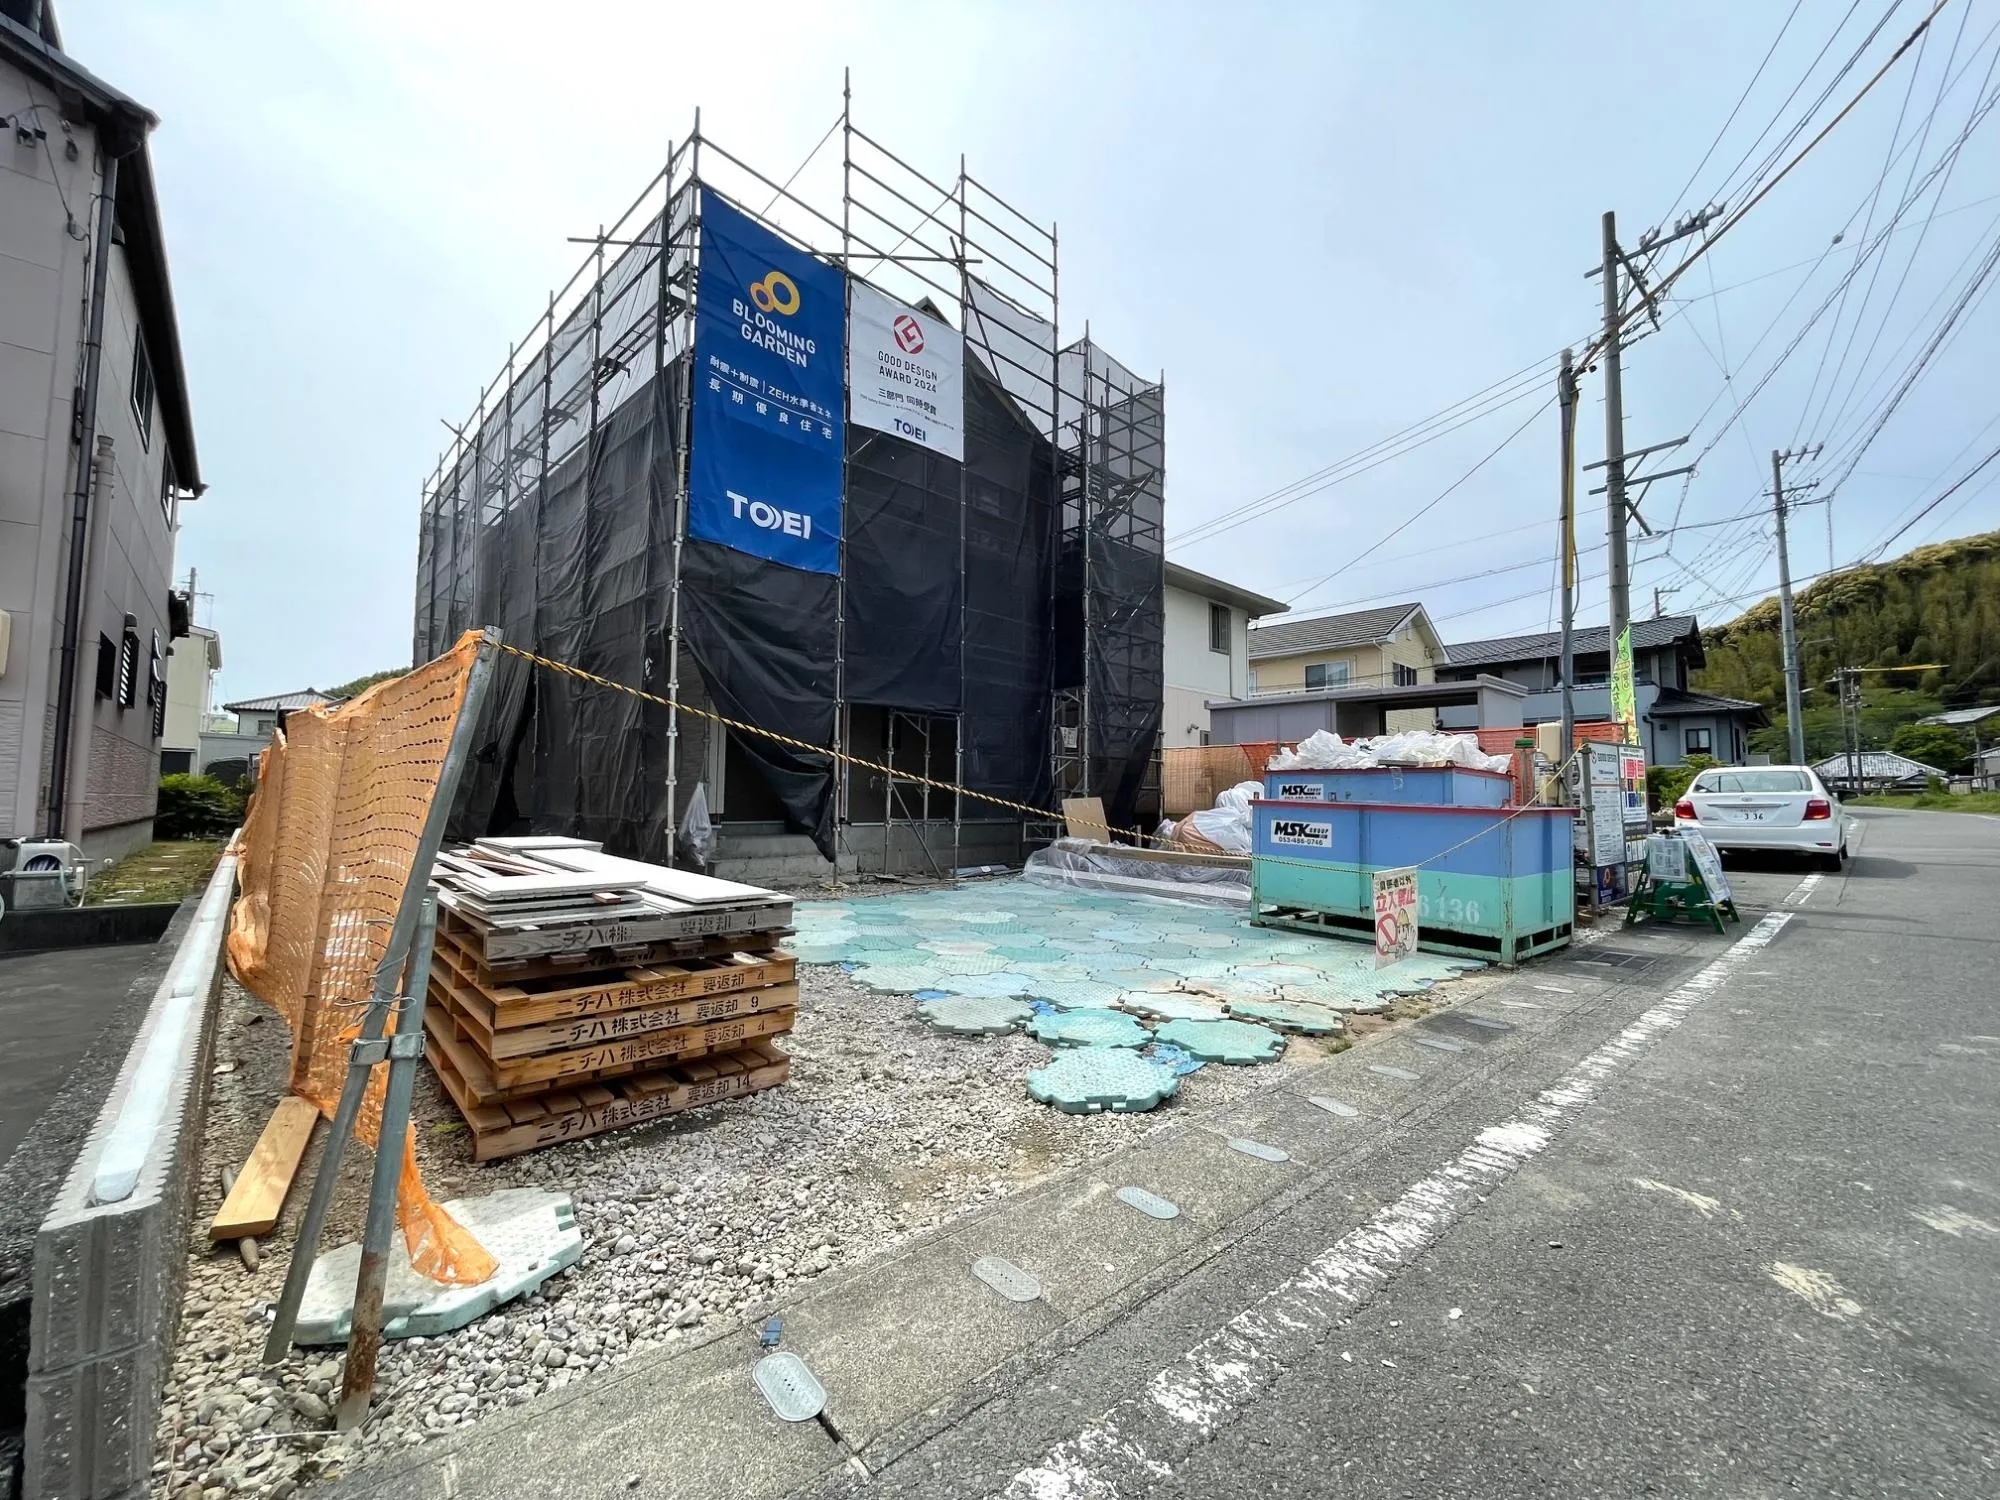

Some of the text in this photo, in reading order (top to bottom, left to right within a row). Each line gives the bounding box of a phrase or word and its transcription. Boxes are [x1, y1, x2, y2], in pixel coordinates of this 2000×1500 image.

[732, 298, 816, 354] BLOOMING
[741, 323, 807, 368] GARDEN
[878, 350, 938, 381] GOOD DESIGN
[879, 365, 937, 393] AWARD 2024
[893, 418, 926, 442] TOEI
[726, 489, 812, 540] TOEI
[1281, 785, 1308, 796] MSK
[1274, 821, 1311, 838] MSK
[1376, 886, 1416, 912] 立入禁止
